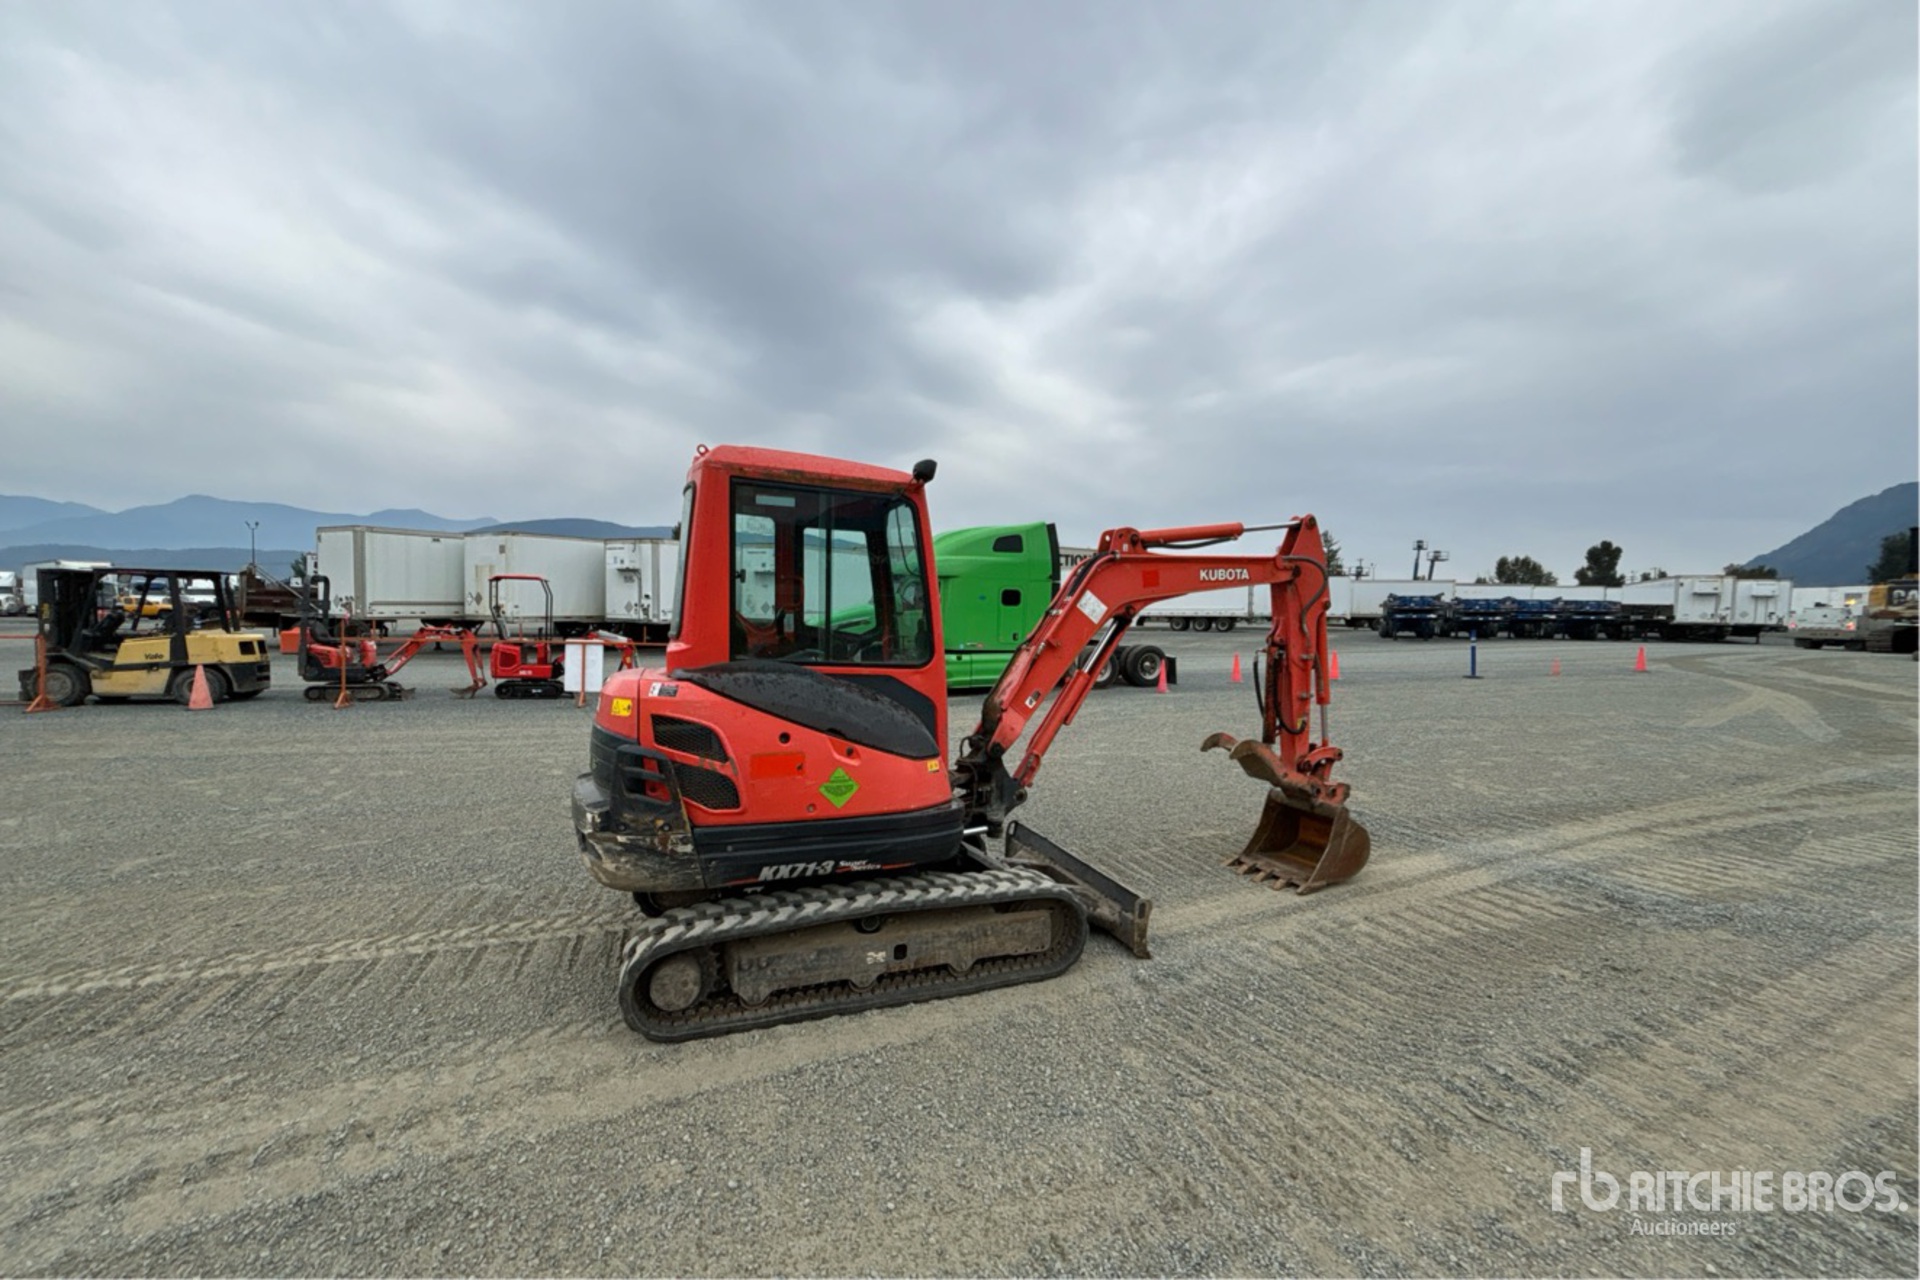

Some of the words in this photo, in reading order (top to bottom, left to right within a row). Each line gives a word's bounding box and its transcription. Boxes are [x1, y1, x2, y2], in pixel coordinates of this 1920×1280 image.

[1199, 568, 1250, 581] KUBOTA
[839, 859, 868, 867] Super
[758, 860, 835, 881] KX71-3
